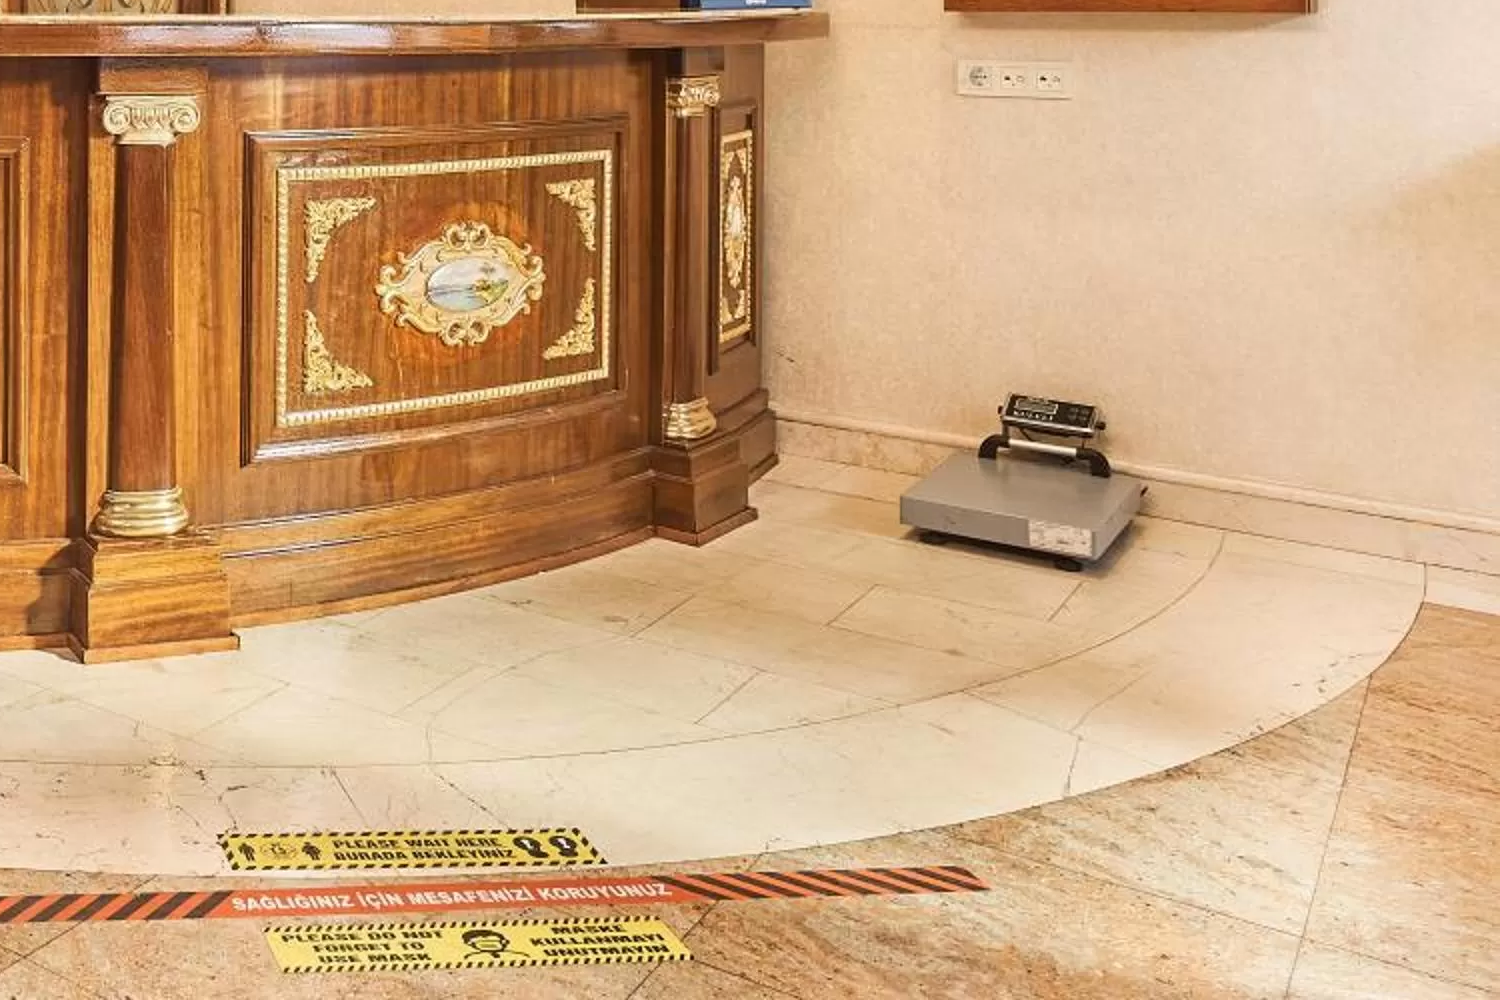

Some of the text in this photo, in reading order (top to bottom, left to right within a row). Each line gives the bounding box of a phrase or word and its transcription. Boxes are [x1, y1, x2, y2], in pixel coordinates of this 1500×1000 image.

[331, 837, 501, 850] PLEASE WAIT HERE
[333, 851, 408, 861] BURADA
[355, 891, 405, 909] İÇİN
[536, 883, 673, 901] KORUYUNUZ
[551, 924, 627, 935] MASKE
[281, 930, 443, 943] PLEASE DO NOT
[529, 933, 665, 947] KULLANMAYI
[312, 941, 425, 952] FORGET TO
[543, 944, 671, 957] UNUTMAYIN
[318, 952, 432, 963] USE MASK
